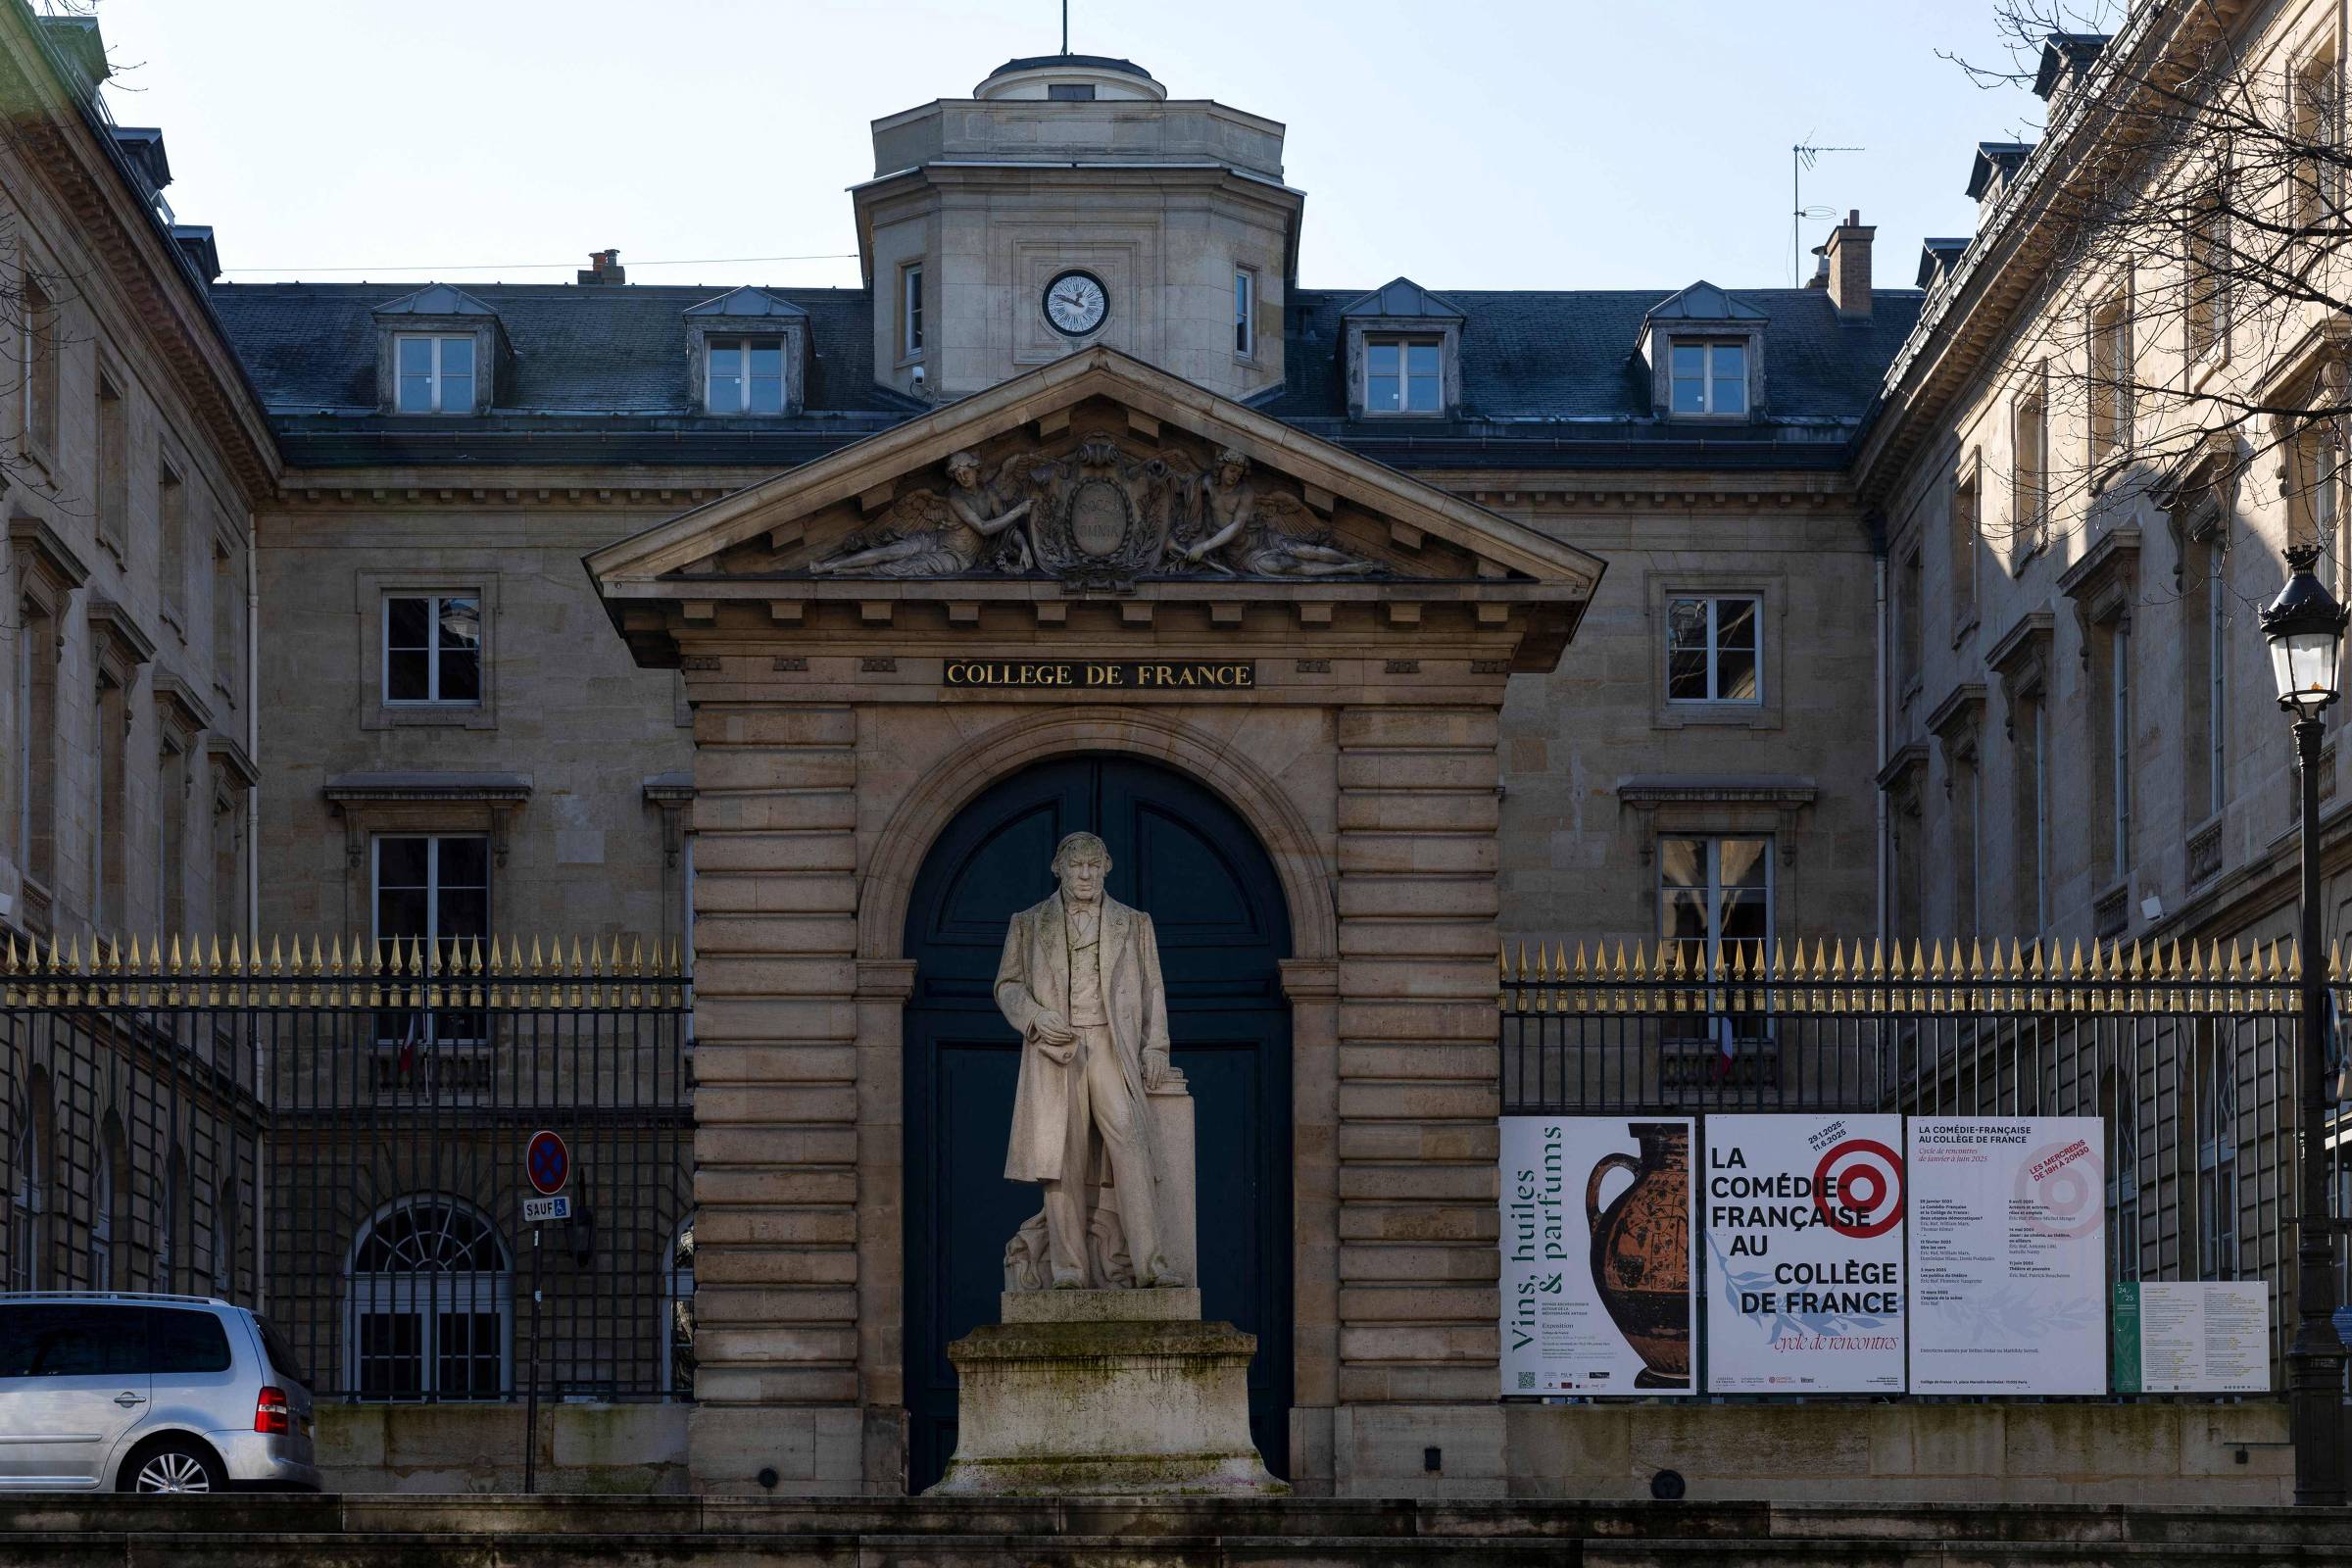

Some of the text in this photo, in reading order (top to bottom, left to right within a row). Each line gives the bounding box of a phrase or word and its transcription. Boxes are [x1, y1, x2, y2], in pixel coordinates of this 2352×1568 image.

[1079, 499, 1120, 516] DOC
[948, 664, 1252, 685] COLLEGE DE FRANCE
[1812, 1129, 1847, 1152] 11.6.2025
[1933, 1124, 2032, 1136] COMÉDIE-FRANÇAISE
[1933, 1134, 1974, 1144] COLLÈGE
[1711, 1147, 1746, 1169] LA
[2029, 1139, 2086, 1175] LES MERCREDIS
[2034, 1171, 2045, 1182] DE
[2045, 1164, 2059, 1175] 19H
[2064, 1146, 2089, 1164] 20H30
[1711, 1172, 1848, 1199] COMÉDIE-
[526, 1201, 553, 1216] SAUF
[1537, 1126, 1568, 1294] & parfums
[1712, 1205, 1871, 1232] FRANÇAISE
[1729, 1235, 1768, 1256] AU
[1510, 1169, 1540, 1352] Vins, huiles
[1774, 1259, 1897, 1285] COLLÈGE
[1741, 1292, 1898, 1314] DE FRANCE
[1774, 1333, 1899, 1353] cycle de rencontres
